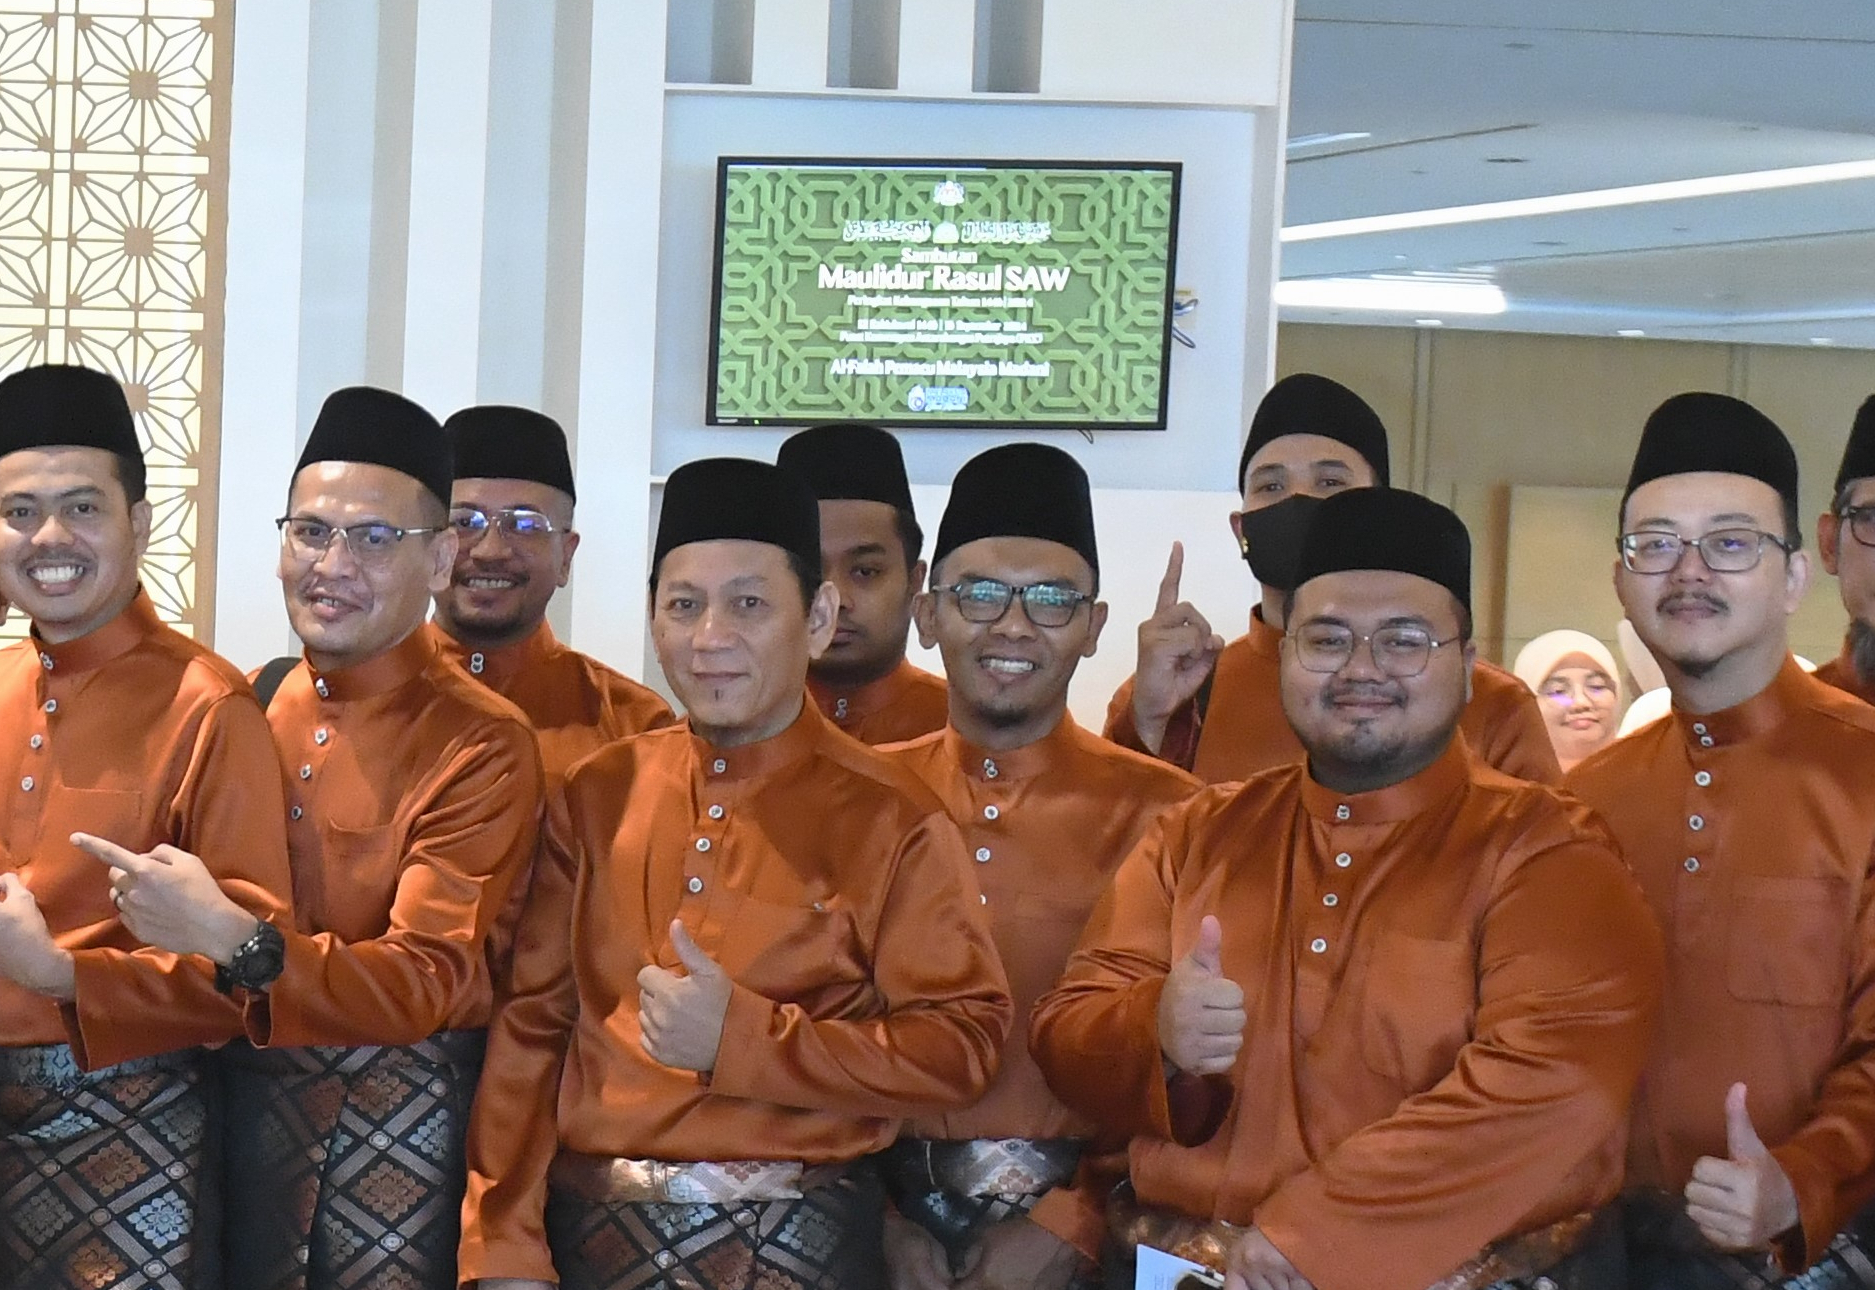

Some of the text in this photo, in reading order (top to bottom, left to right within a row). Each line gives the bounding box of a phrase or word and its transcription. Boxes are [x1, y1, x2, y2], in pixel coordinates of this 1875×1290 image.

[901, 247, 978, 264] Sambutan
[818, 262, 1071, 292] Maulidur Rasul SAW
